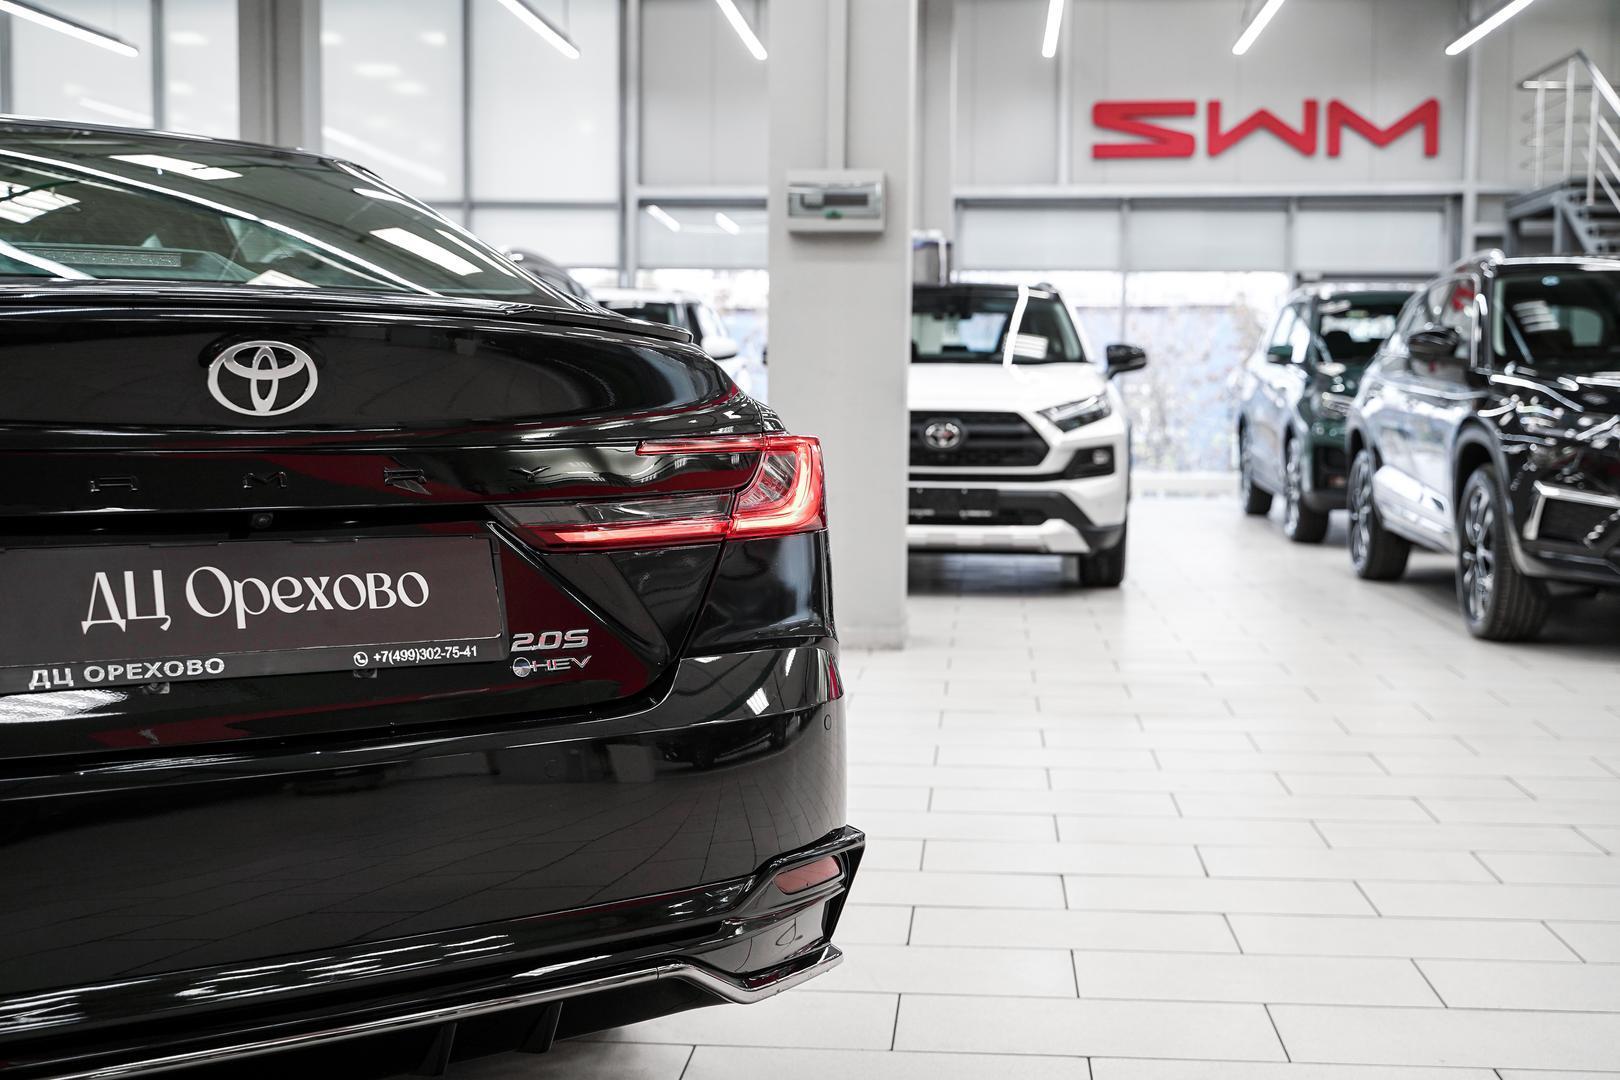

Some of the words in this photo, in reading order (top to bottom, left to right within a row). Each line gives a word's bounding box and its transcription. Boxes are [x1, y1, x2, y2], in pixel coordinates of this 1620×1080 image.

[1091, 98, 1440, 160] SWM
[81, 569, 171, 635] ДЦ
[185, 565, 430, 630] Орехово
[28, 667, 75, 690] ДЦ
[83, 657, 225, 683] ОРЕХОВО
[373, 645, 478, 664] +7(499)302-75-41
